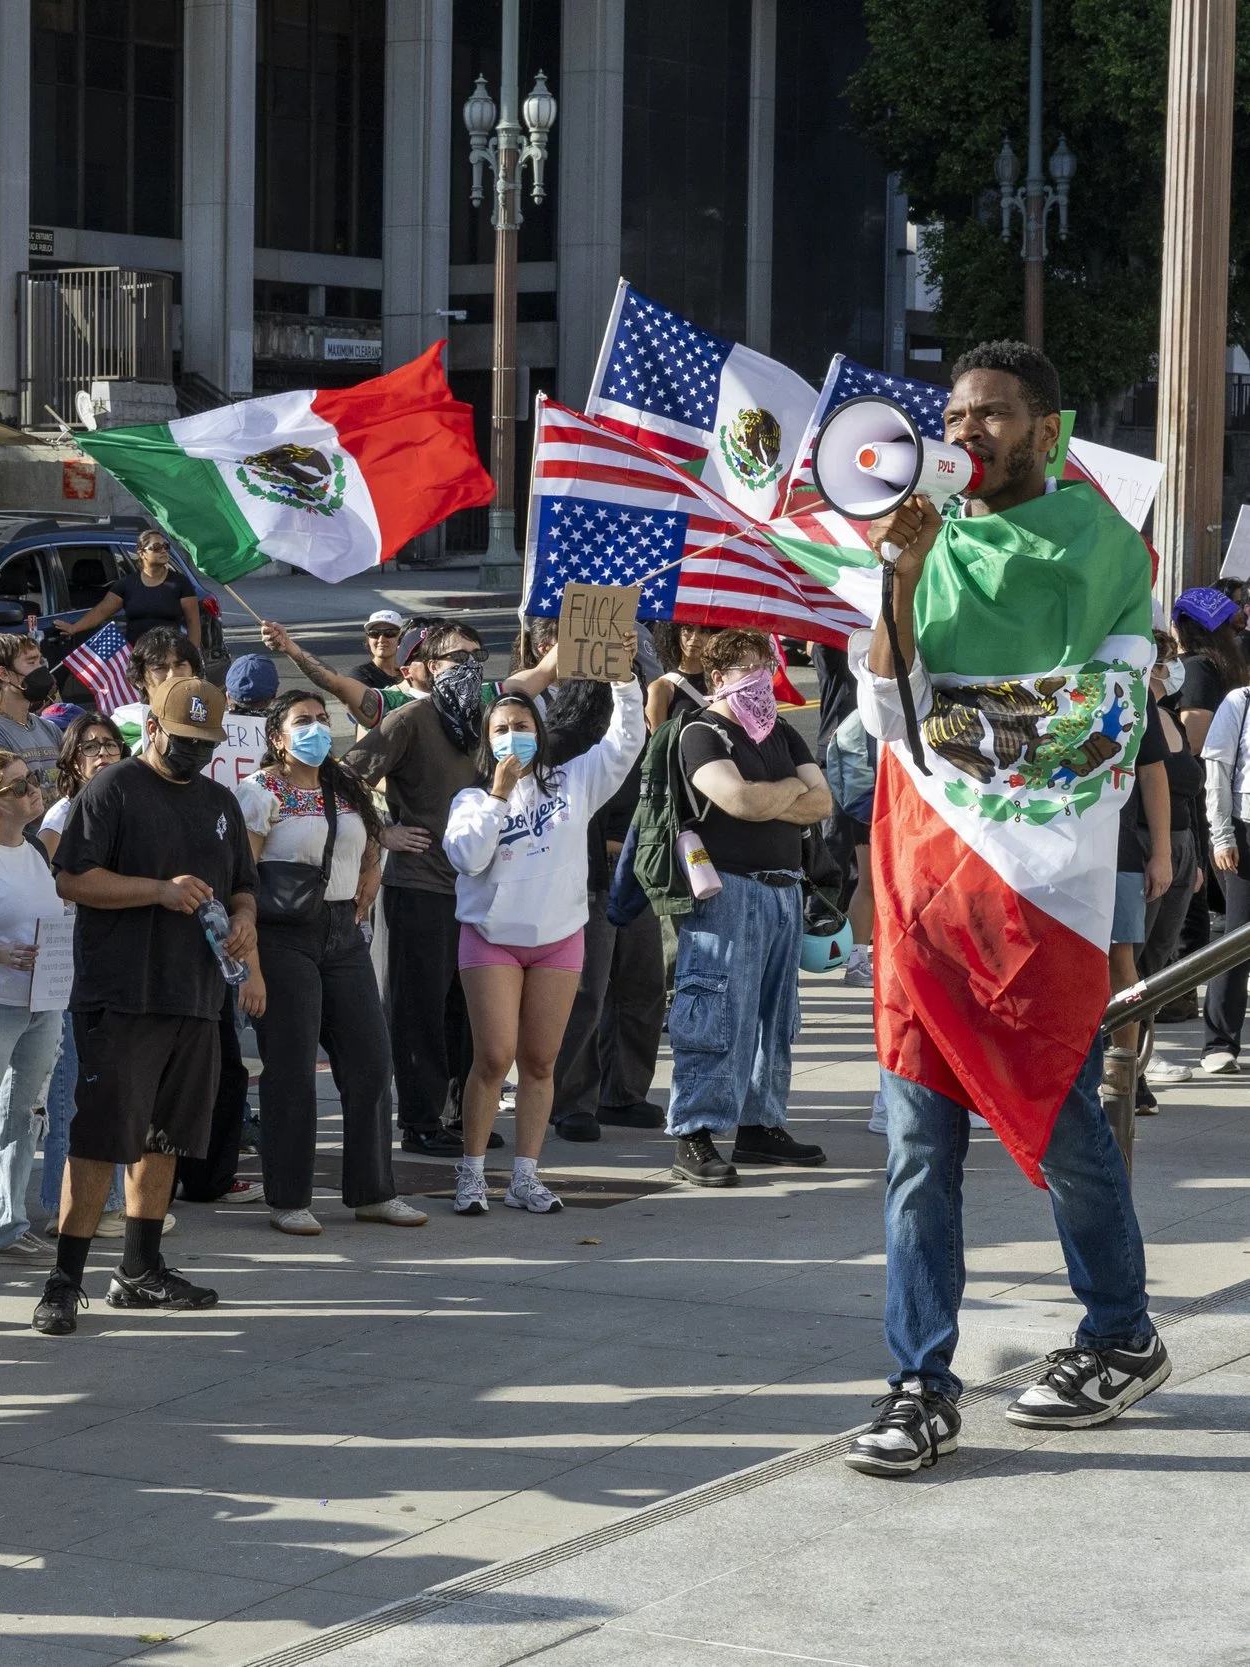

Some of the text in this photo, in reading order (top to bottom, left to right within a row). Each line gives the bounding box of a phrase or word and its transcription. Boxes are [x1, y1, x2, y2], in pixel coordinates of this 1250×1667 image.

[327, 343, 354, 357] MAXIMUM
[937, 459, 956, 474] PYLE
[569, 593, 624, 641] FUCK
[571, 638, 624, 679] ICE
[189, 696, 208, 722] LA
